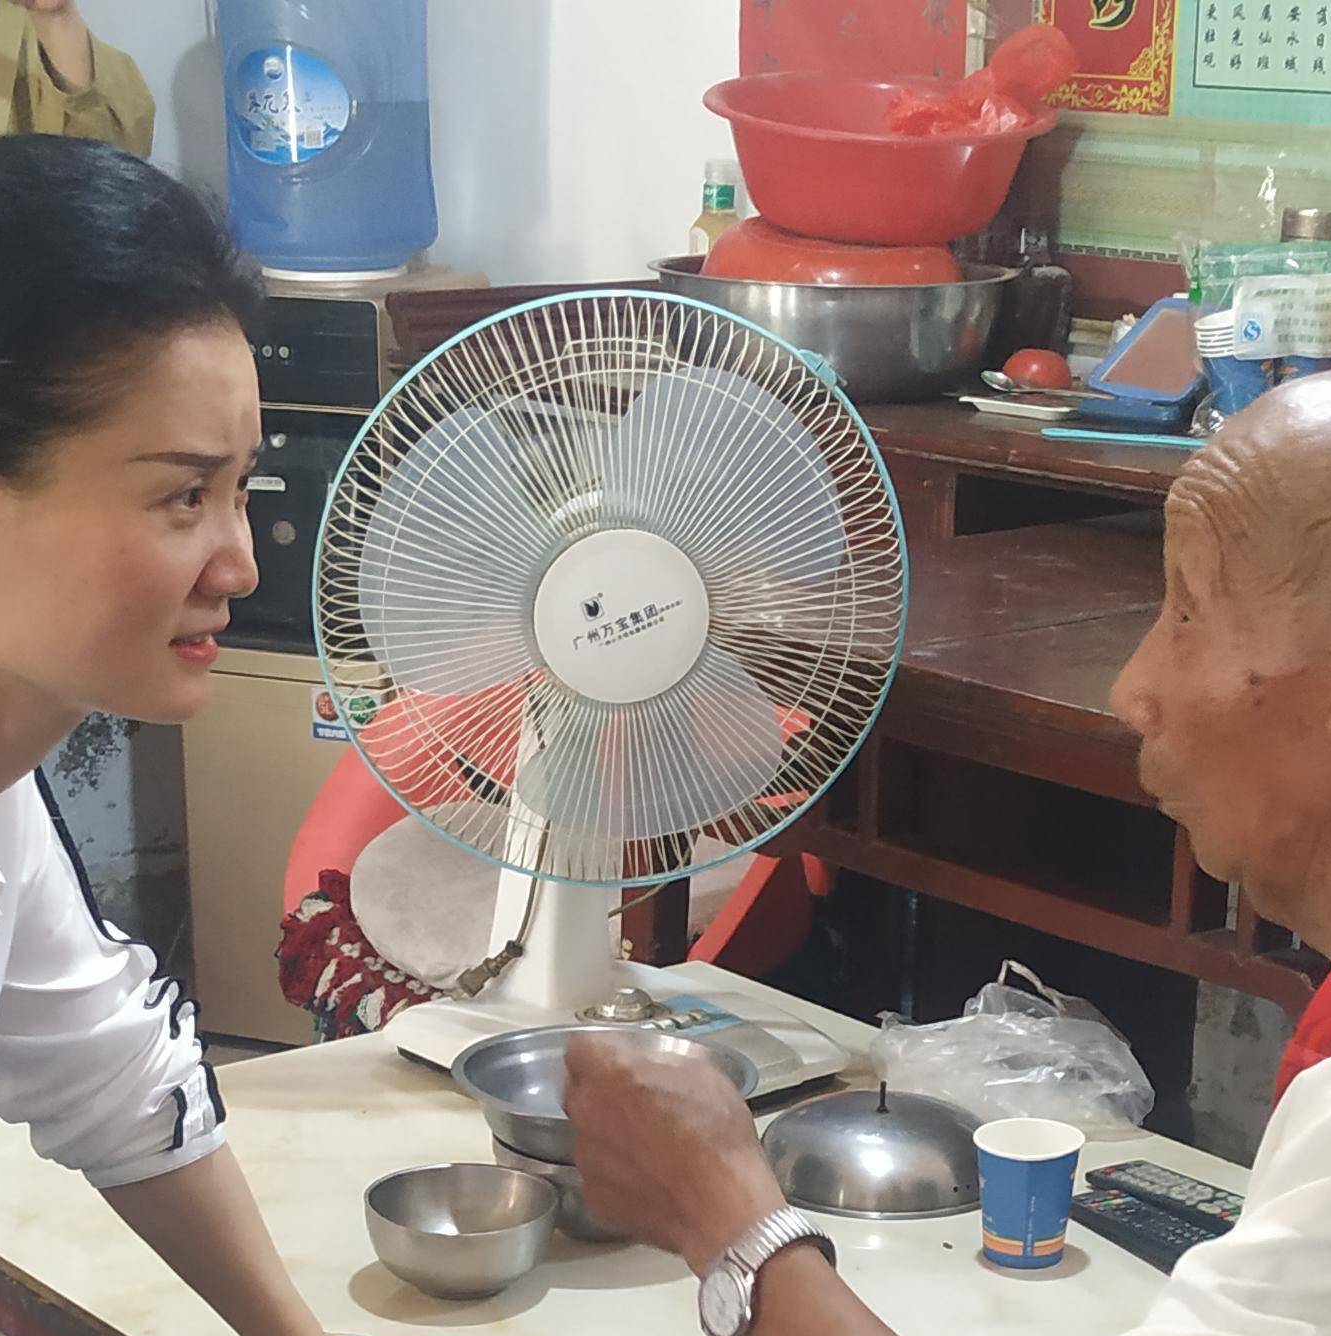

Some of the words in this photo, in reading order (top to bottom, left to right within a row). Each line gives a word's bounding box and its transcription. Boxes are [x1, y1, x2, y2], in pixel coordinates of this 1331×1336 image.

[572, 603, 659, 651] 广州万宝集团
